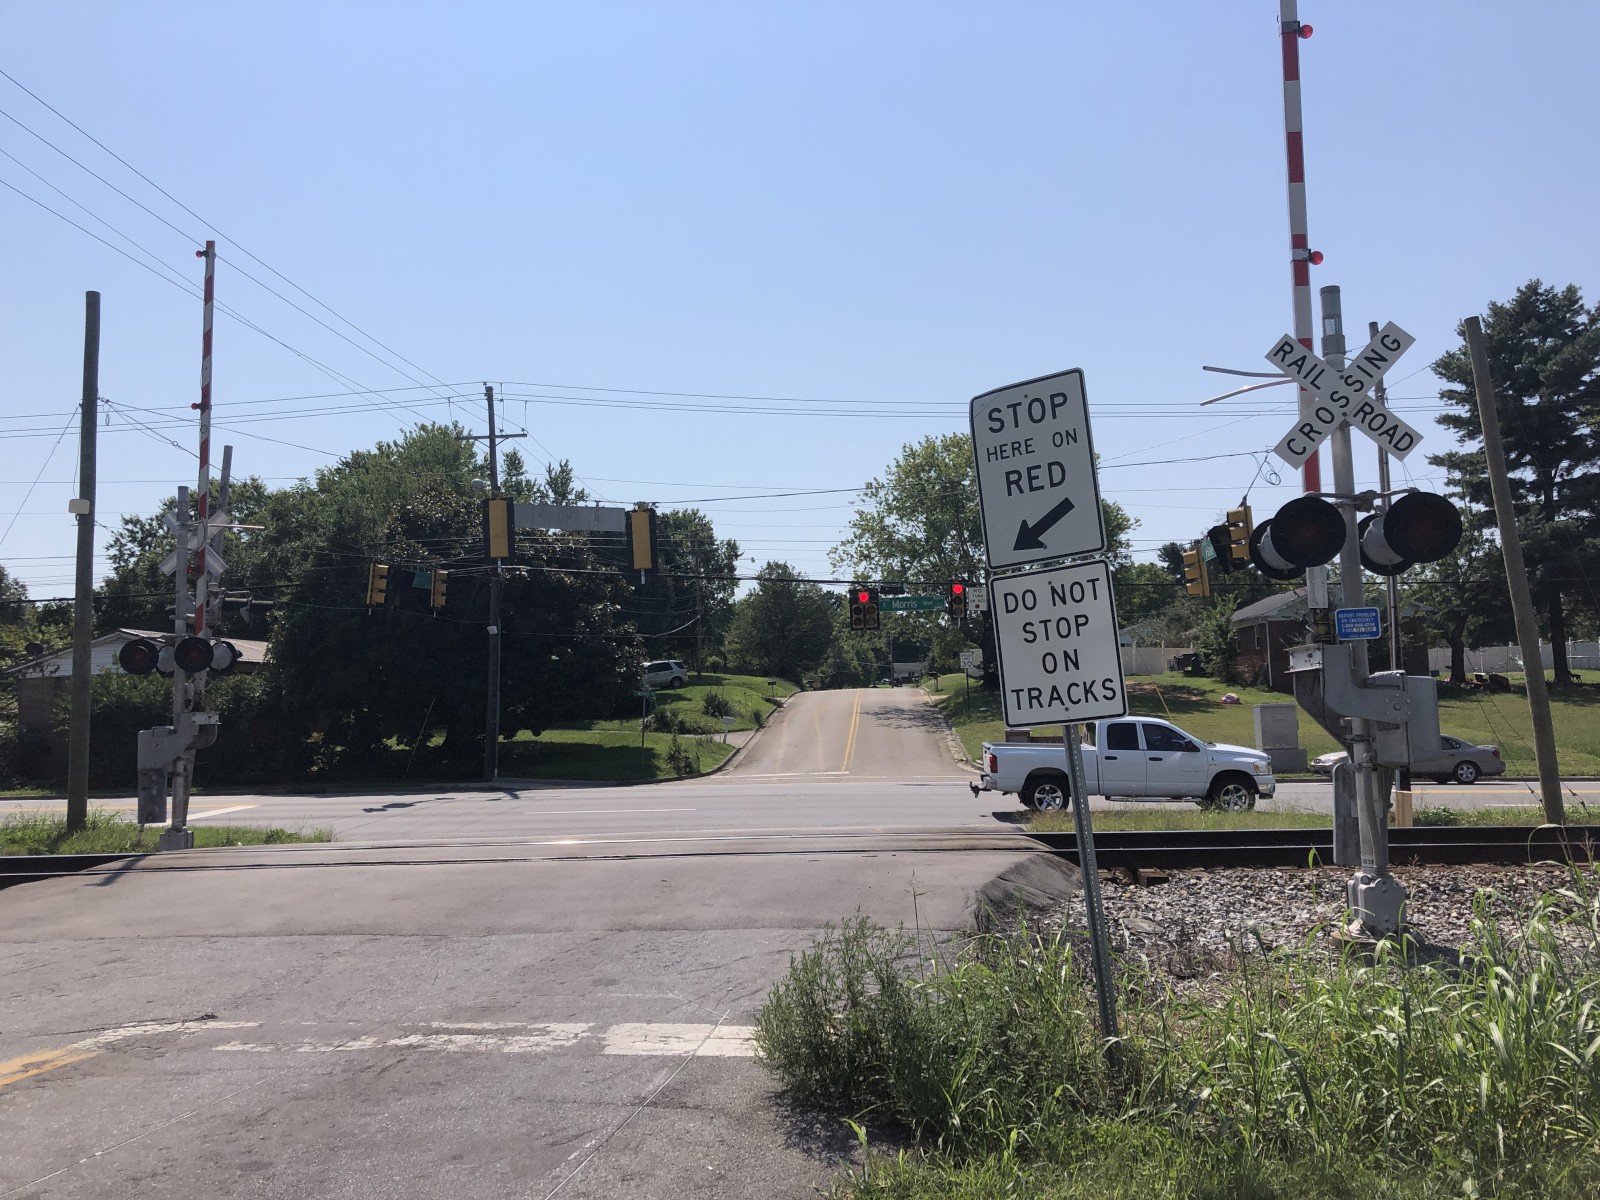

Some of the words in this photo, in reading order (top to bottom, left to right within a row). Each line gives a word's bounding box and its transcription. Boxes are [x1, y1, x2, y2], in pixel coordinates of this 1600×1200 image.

[988, 392, 1068, 433] STOP
[1273, 340, 1326, 391] RAIL
[1353, 401, 1414, 452] ROAD
[1286, 334, 1401, 456] CROSSING
[986, 437, 1036, 462] HERE
[1052, 428, 1078, 448] ON
[1005, 460, 1066, 497] RED
[892, 600, 918, 609] Morris
[1003, 588, 1037, 614] DO
[1050, 577, 1100, 607] NOT
[1022, 614, 1089, 644] STOP
[1042, 648, 1080, 674] ON
[1011, 677, 1117, 710] TRACKS
